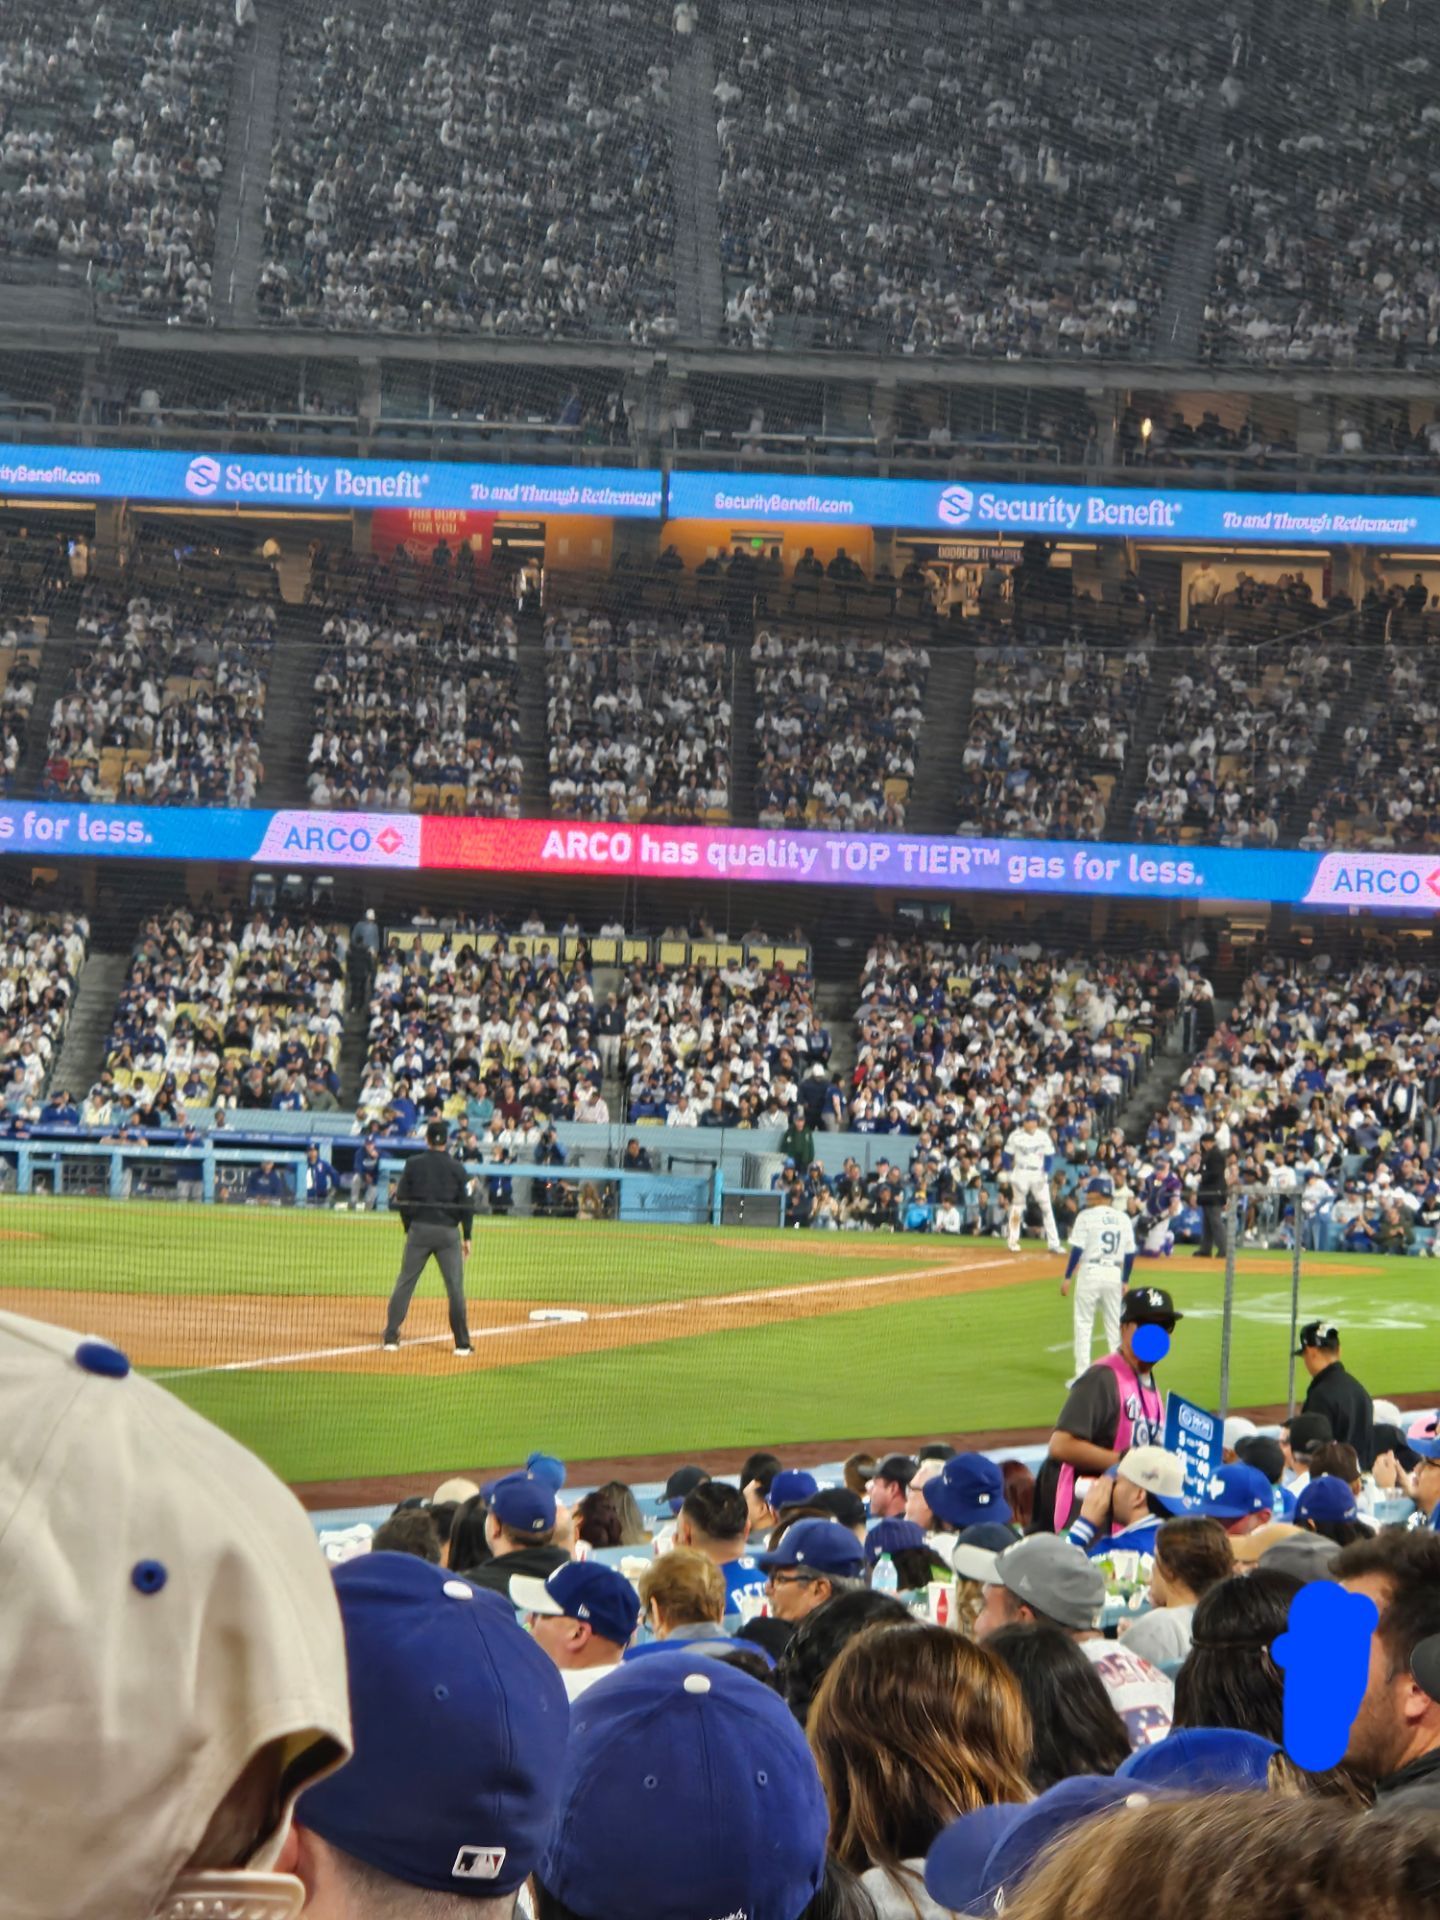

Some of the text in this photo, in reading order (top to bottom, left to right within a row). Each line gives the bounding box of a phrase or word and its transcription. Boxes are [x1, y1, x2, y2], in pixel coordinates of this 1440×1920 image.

[226, 463, 328, 500] Security
[471, 484, 489, 500] To
[491, 484, 519, 500] and
[521, 484, 579, 507] Through
[714, 492, 854, 514] SecurityBenefit.com
[979, 493, 1081, 529] Security
[1223, 512, 1242, 528] To
[1243, 512, 1272, 530] and
[1274, 513, 1330, 534] Through
[413, 522, 432, 534] FOR
[23, 810, 70, 840] for
[78, 811, 153, 844] less.
[283, 825, 371, 852] ARCO
[541, 829, 632, 862] ARCO
[641, 832, 699, 865] has
[706, 838, 819, 874] quality
[825, 840, 890, 872] TOP
[1008, 854, 1065, 884] gas
[1073, 851, 1121, 881] for
[1129, 853, 1204, 886] less.
[1332, 867, 1420, 894] ARCO
[1101, 1230, 1121, 1255] 91
